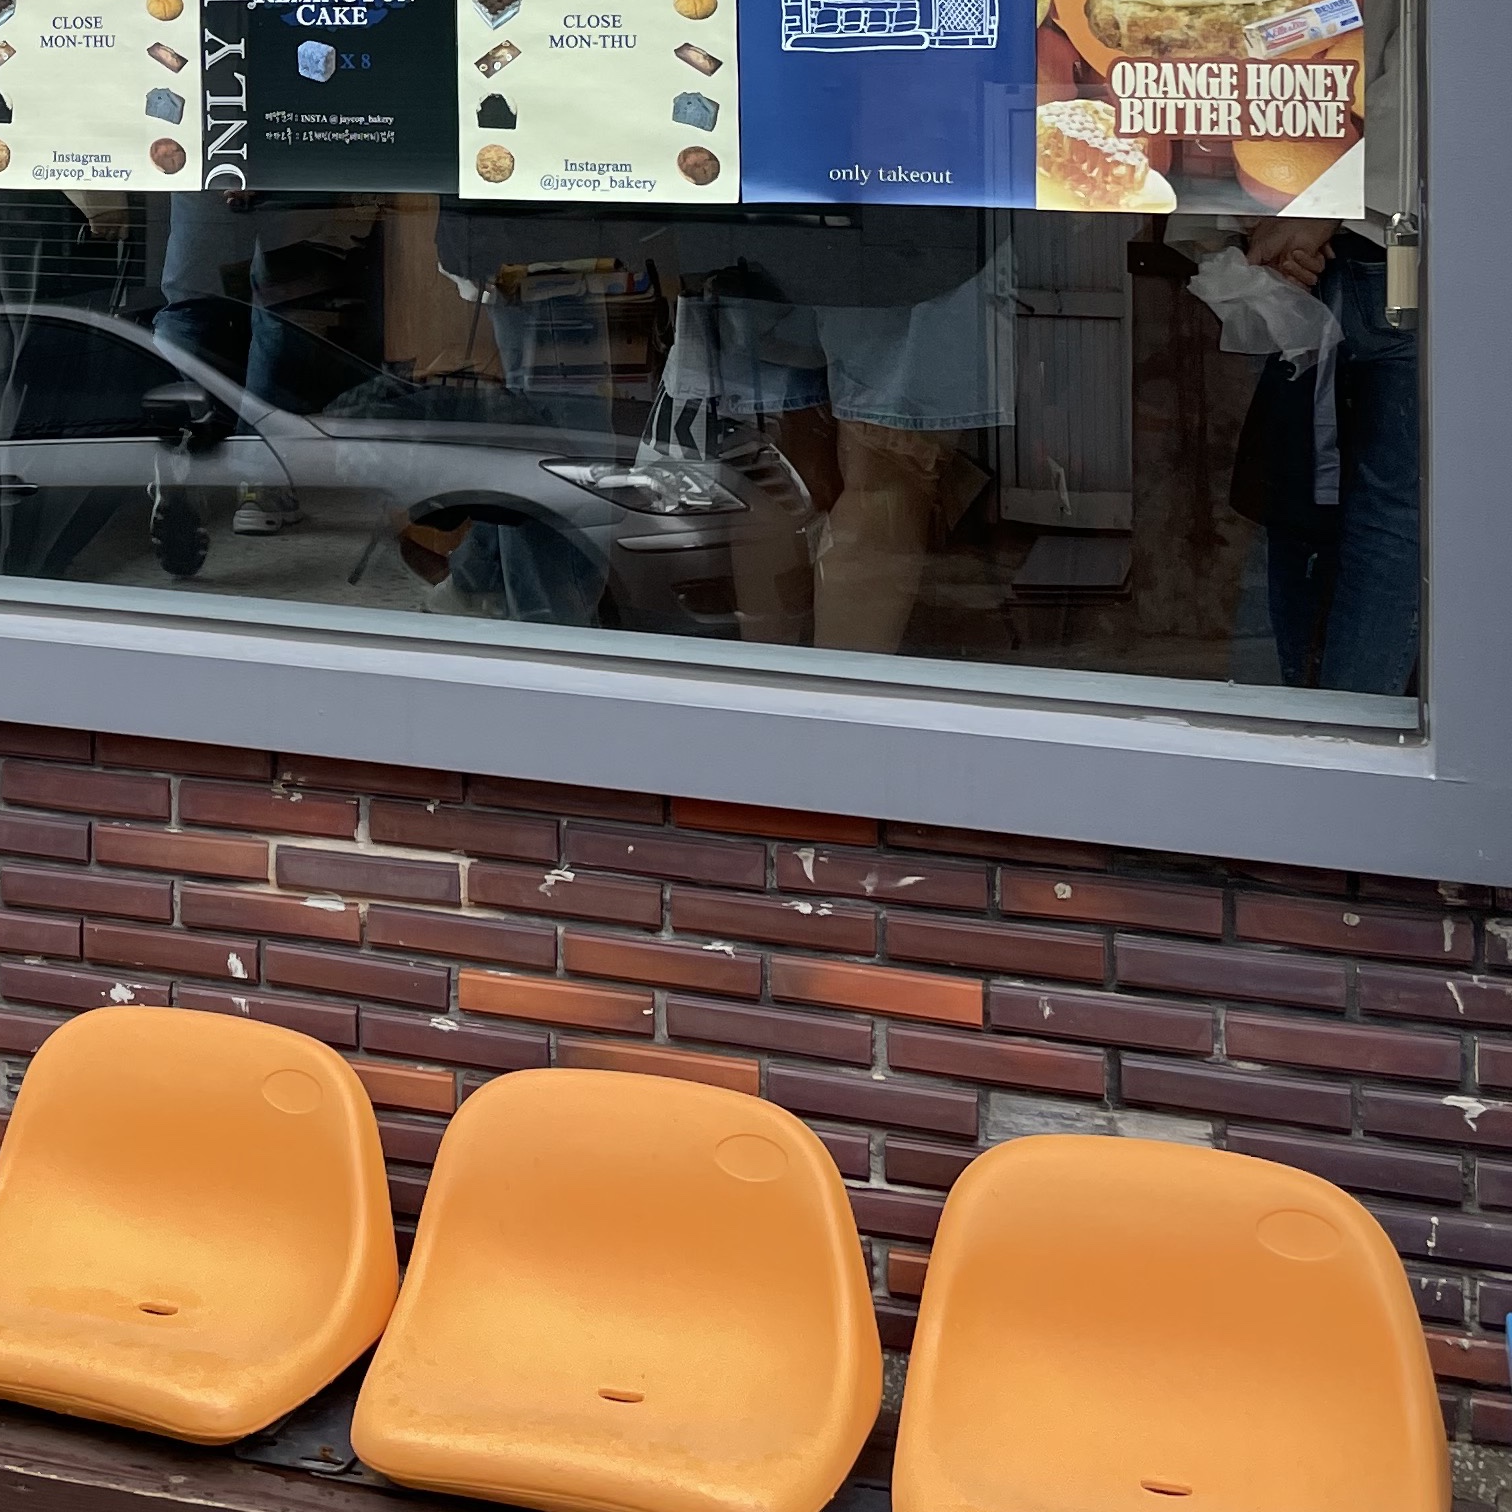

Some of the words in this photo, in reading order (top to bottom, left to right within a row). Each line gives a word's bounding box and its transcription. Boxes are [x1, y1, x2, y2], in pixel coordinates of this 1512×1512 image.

[52, 17, 103, 30] CLOSE
[296, 5, 368, 26] CAKE
[563, 14, 622, 29] CLOSE
[40, 35, 116, 48] MON-THU
[549, 35, 637, 49] MON-THU
[361, 53, 372, 69] 8
[1111, 61, 1238, 99] ORANGE
[1246, 63, 1354, 102] HONEY
[1119, 98, 1242, 135] BUTTER
[1249, 100, 1346, 138] SCONE
[52, 151, 111, 165] Instagram
[32, 165, 132, 181] @jaycop_bakery
[564, 159, 632, 175] Instagram
[829, 164, 872, 185] only
[878, 165, 954, 185] takeout
[540, 175, 656, 192] @jaycop_bakery
